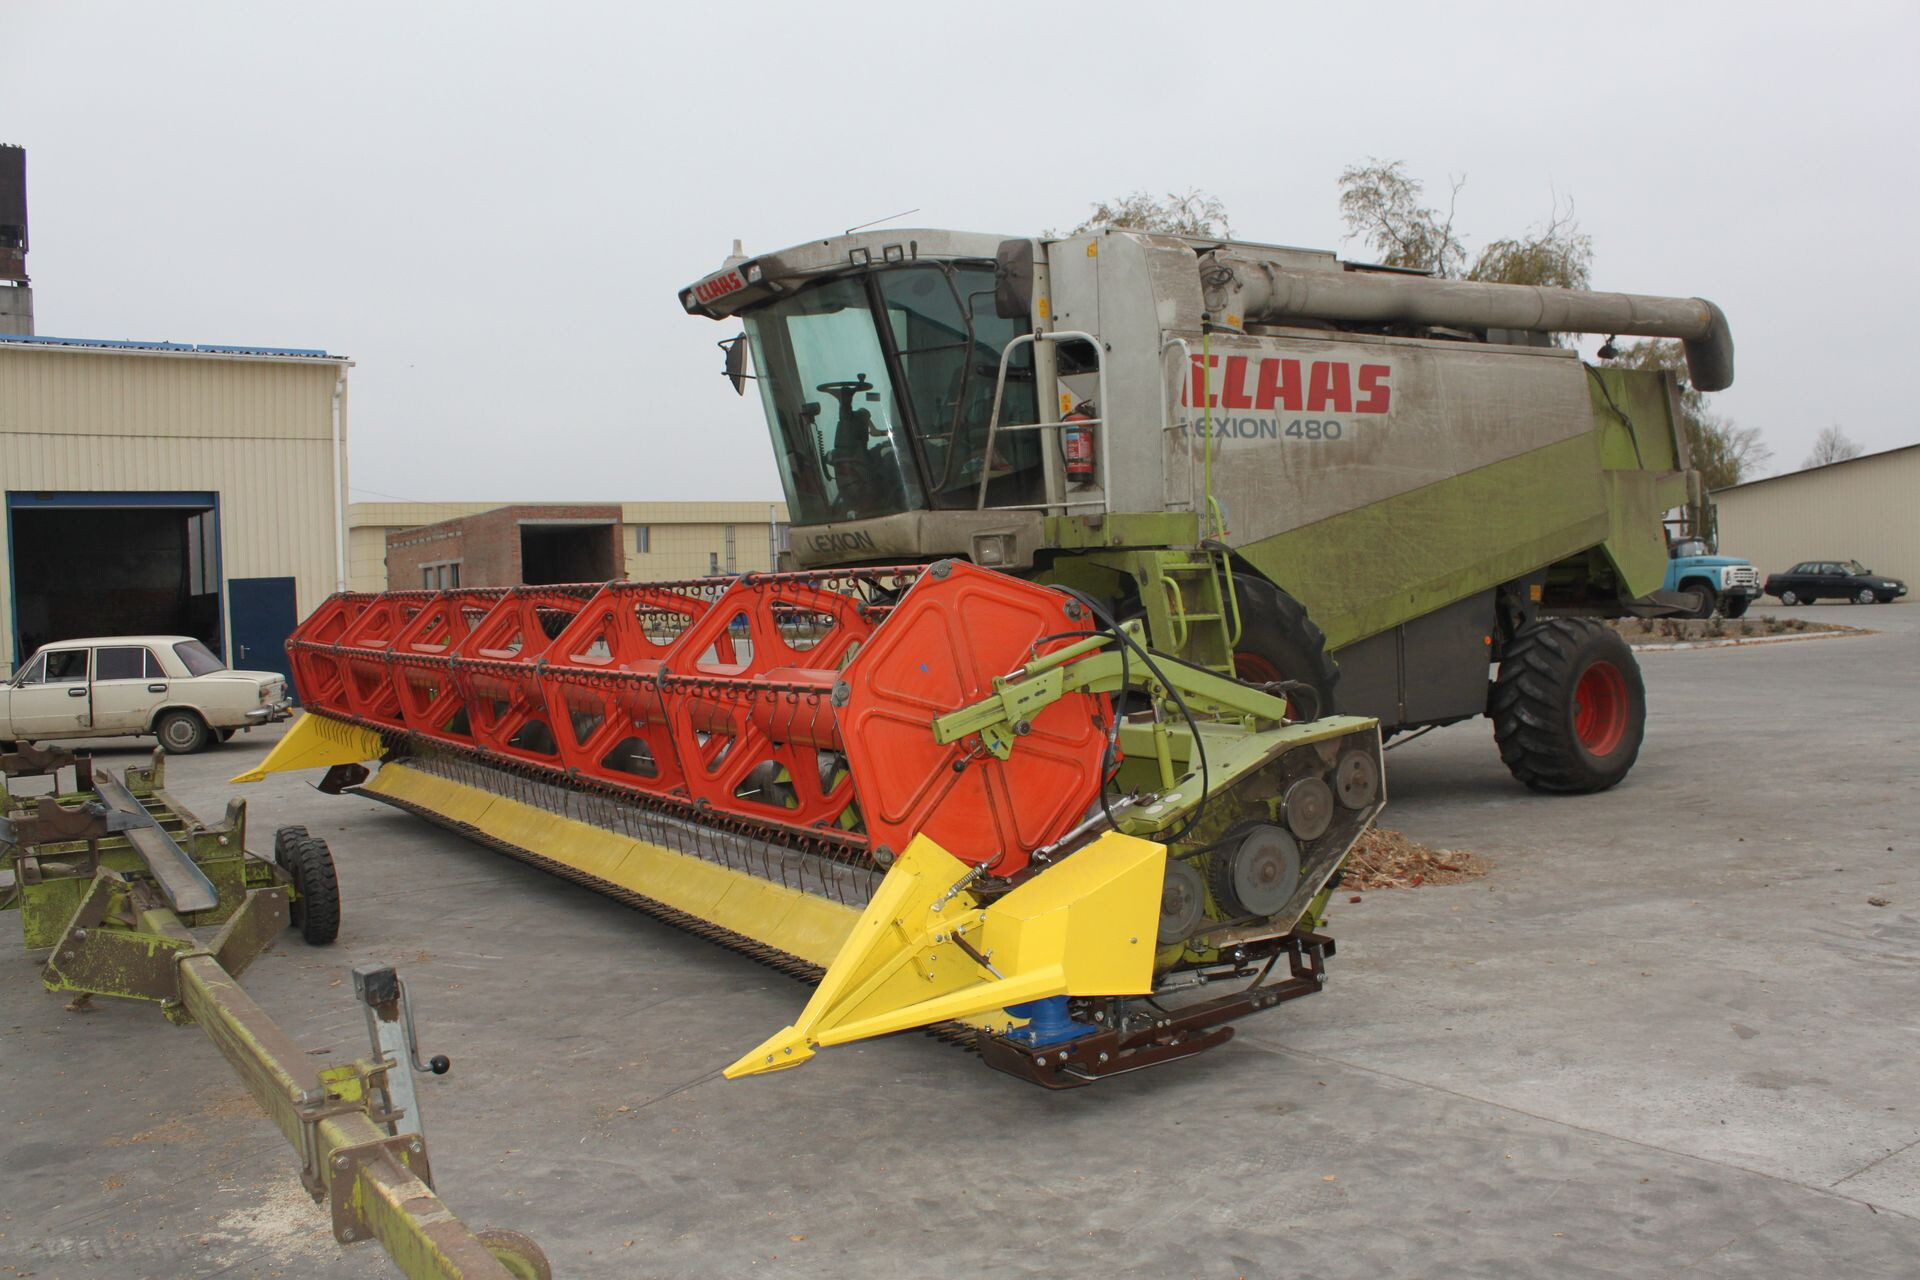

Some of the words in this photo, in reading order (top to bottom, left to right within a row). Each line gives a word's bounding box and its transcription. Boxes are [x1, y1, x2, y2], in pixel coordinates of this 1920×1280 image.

[695, 272, 742, 302] CLAAS
[1181, 354, 1391, 414] CLAAS
[1285, 419, 1342, 440] 480
[806, 530, 877, 553] LEXION
